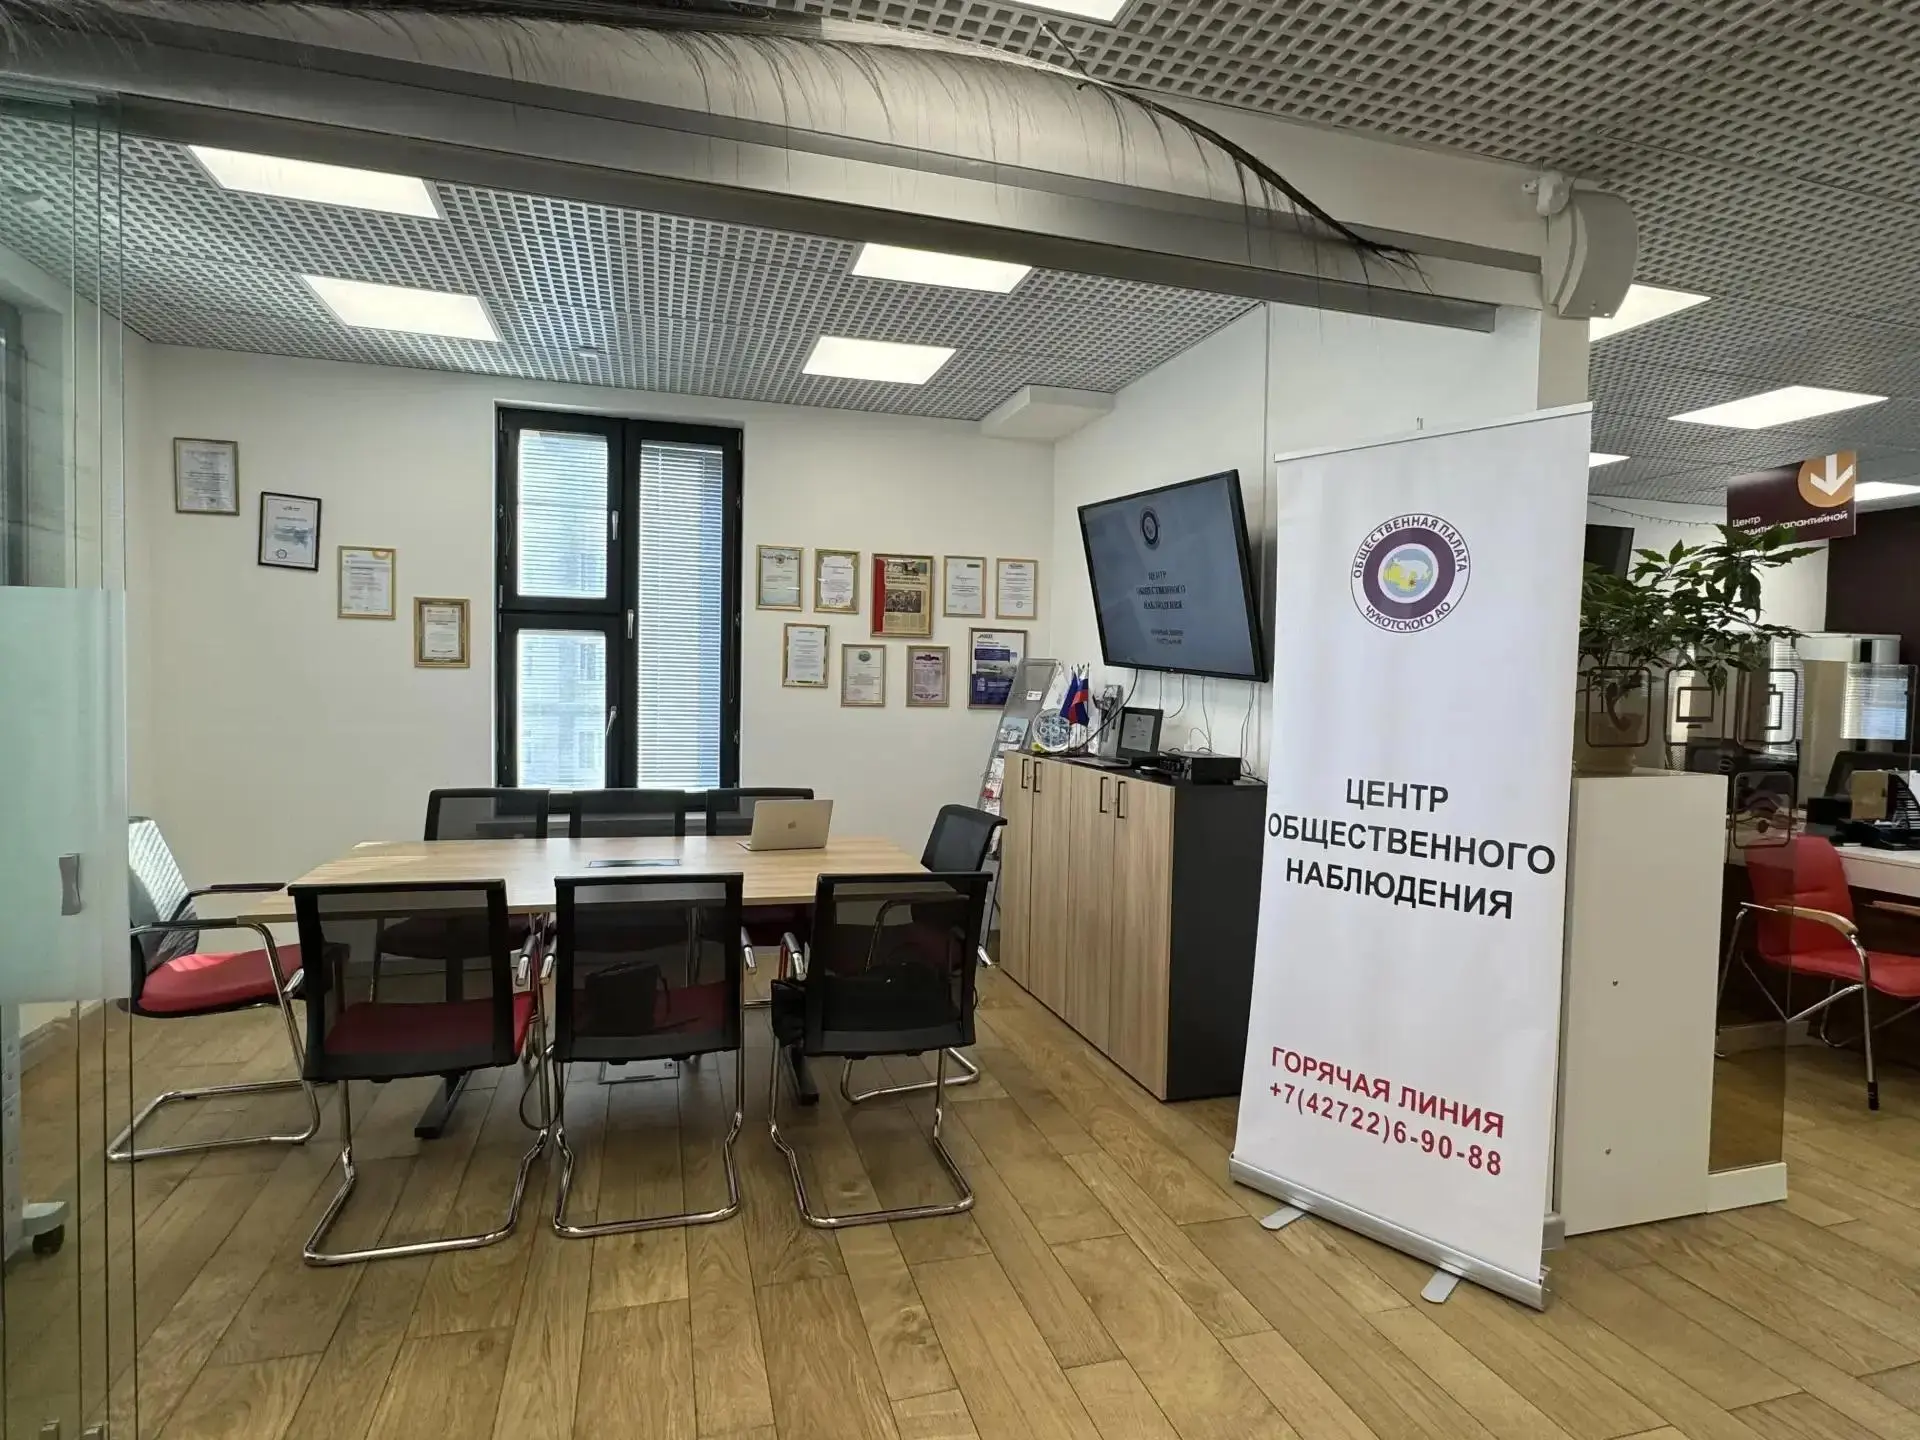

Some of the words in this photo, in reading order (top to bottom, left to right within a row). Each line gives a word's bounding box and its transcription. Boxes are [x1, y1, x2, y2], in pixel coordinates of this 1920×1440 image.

[1353, 516, 1439, 579] ОБЩЕСТВЕННАЯ
[1438, 523, 1468, 573] ПАЛАТА
[1732, 516, 1761, 528] Центр
[1365, 604, 1434, 631] ЧУКОТСКОГО
[1434, 601, 1451, 619] АО
[1346, 778, 1449, 812] ЦЕНТР
[1268, 813, 1556, 875] ОБЩЕСТВЕННОГО
[1286, 857, 1513, 919] НАБЛЮДЕНИЯ
[1271, 1046, 1391, 1103] ГОРЯЧАЯ
[1398, 1086, 1505, 1138] ЛИНИЯ
[1269, 1082, 1502, 1176] +7(42722)6-90-88
